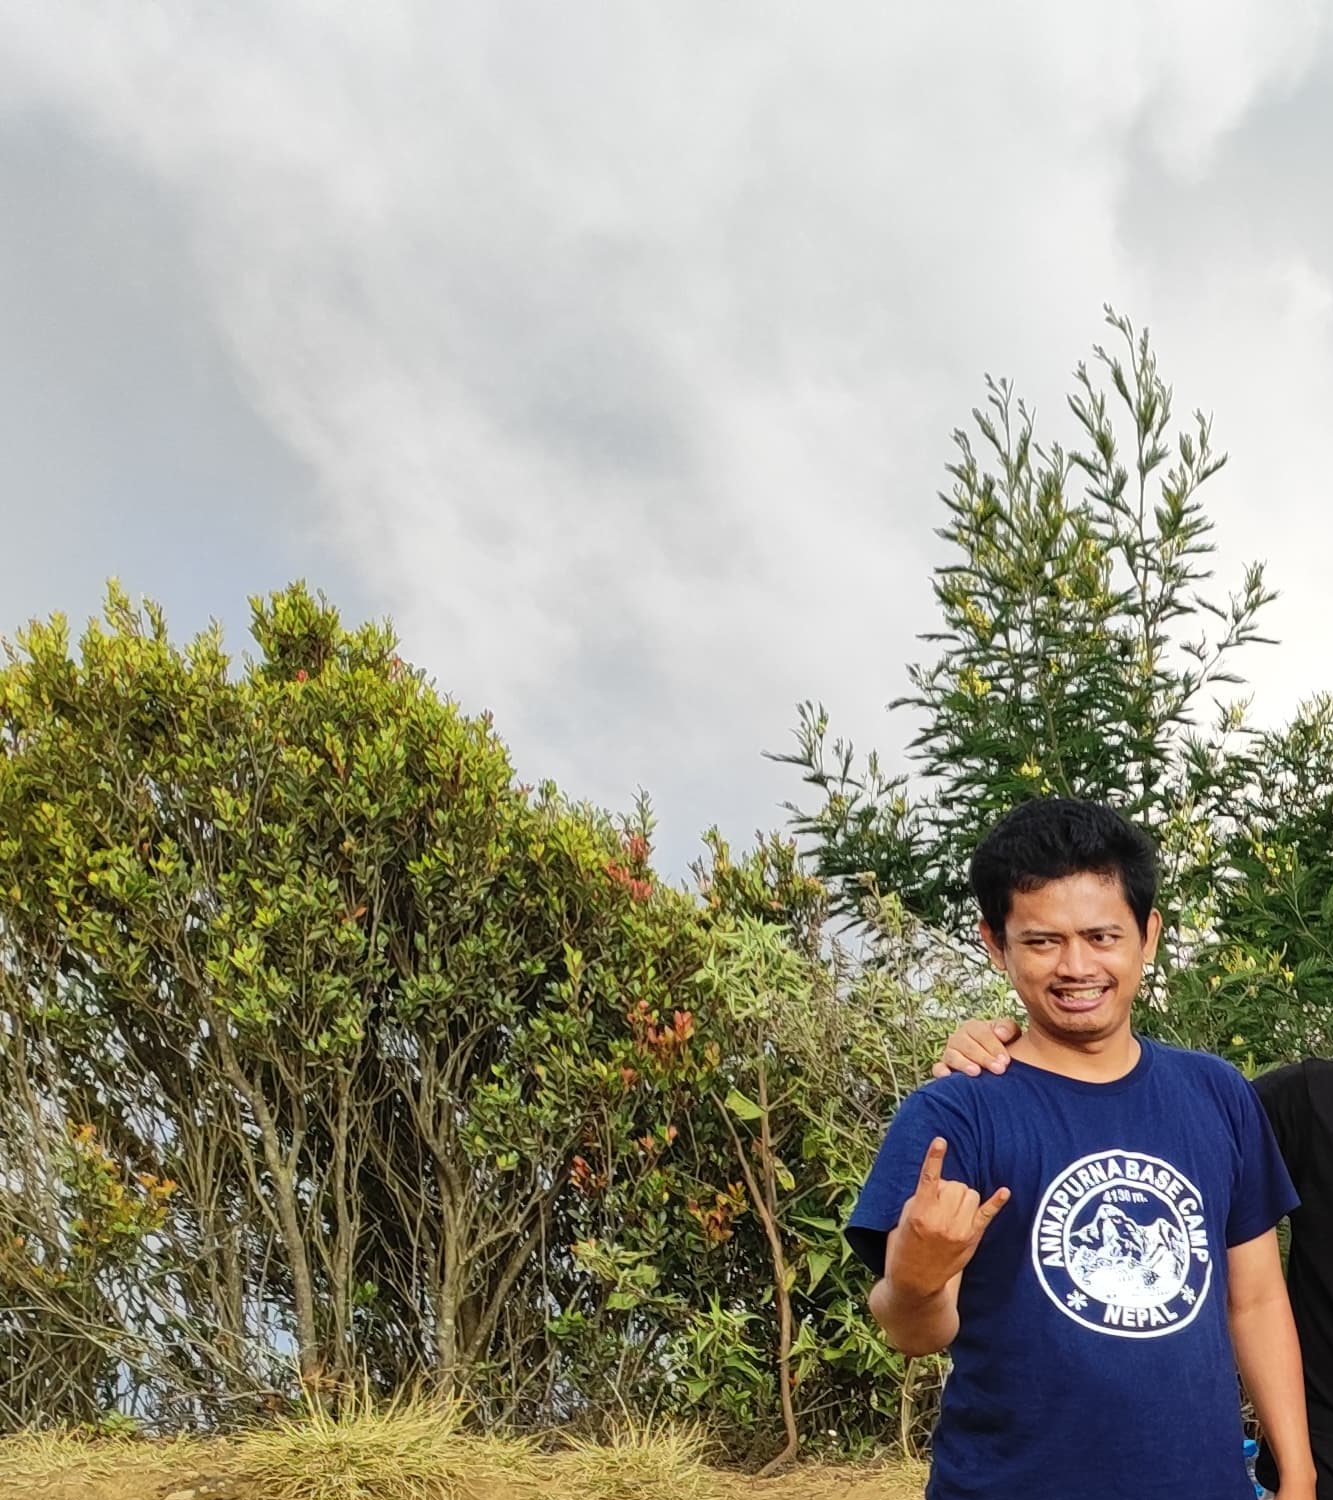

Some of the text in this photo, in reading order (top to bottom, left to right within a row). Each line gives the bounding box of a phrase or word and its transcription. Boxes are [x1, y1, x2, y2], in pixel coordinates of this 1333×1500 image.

[1038, 1158, 1209, 1267] ANNAPURNA BASE CAMP
[1103, 1304, 1179, 1328] NEPAL
